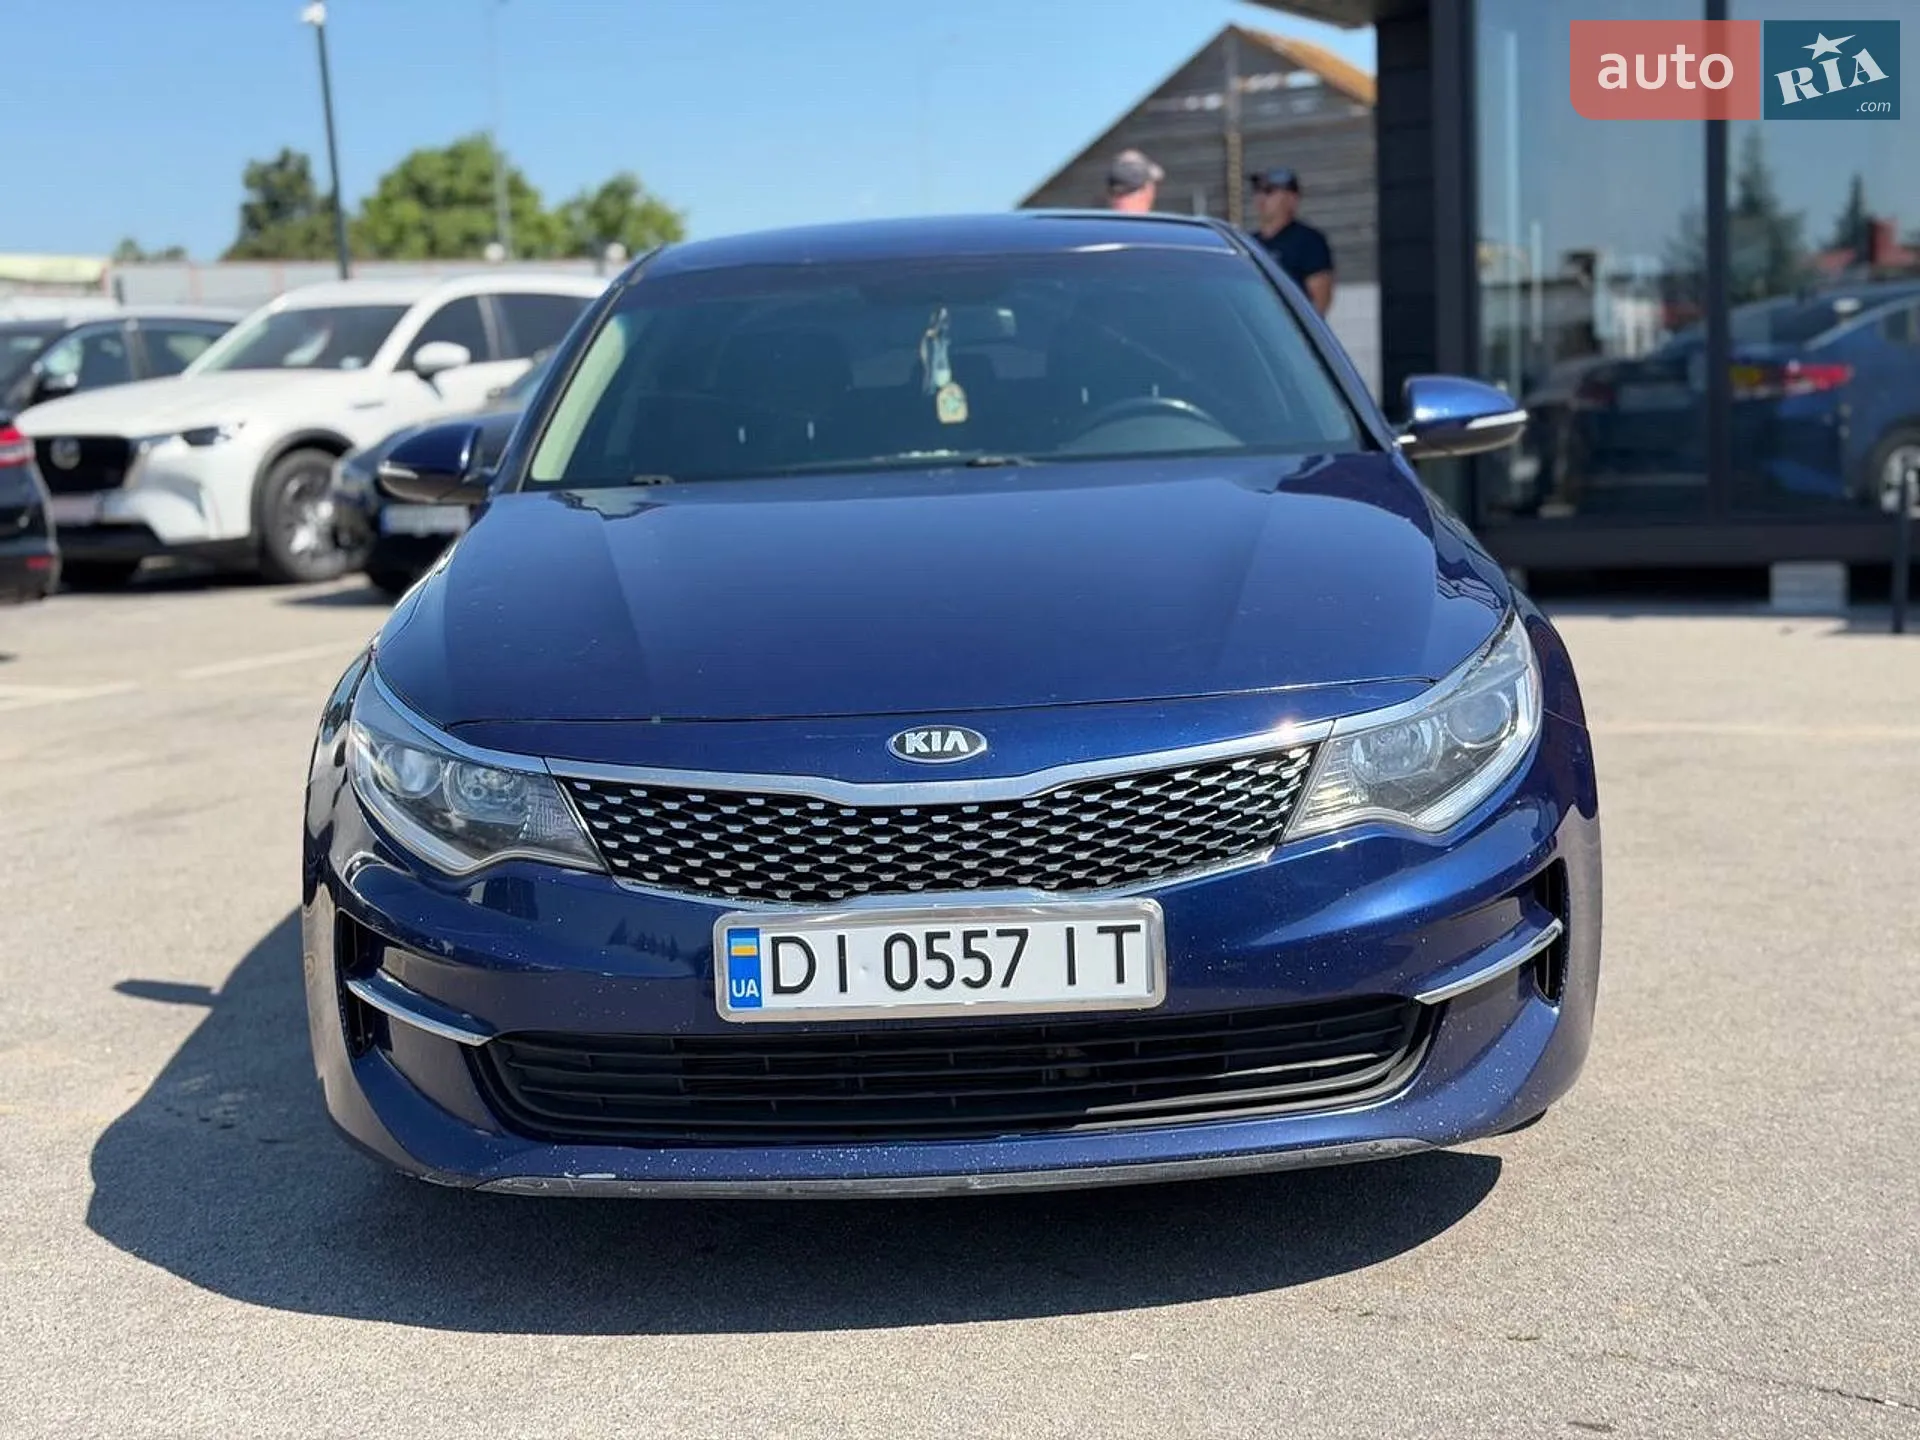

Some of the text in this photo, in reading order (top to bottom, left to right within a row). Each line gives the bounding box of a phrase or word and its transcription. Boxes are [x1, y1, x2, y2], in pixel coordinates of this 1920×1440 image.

[905, 731, 969, 753] KIA
[771, 924, 1141, 995] DI 0557 IT
[732, 978, 760, 998] UA
